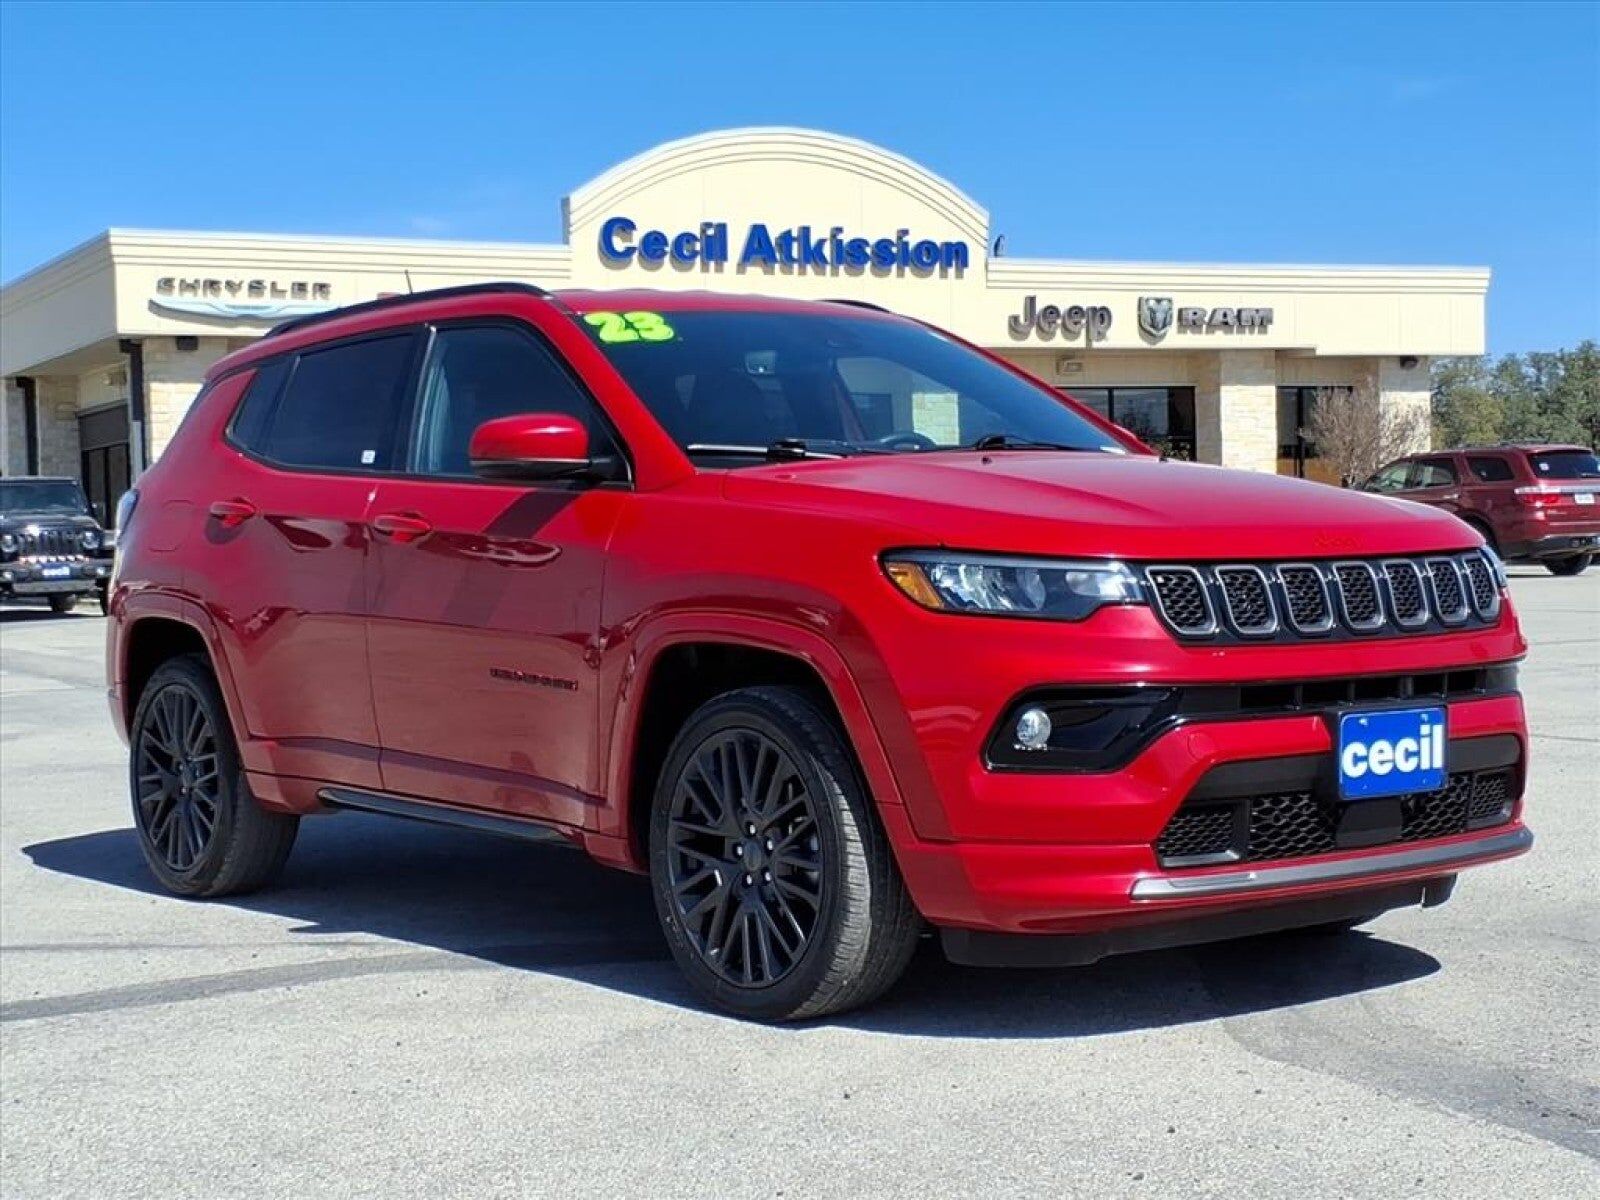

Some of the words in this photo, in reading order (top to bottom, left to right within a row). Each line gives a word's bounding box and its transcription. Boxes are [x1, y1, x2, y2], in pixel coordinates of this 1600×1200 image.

[599, 216, 728, 266] Cecil
[739, 223, 969, 272] Atkission
[157, 277, 331, 299] CHRYSLER
[583, 311, 674, 342] 23
[1008, 295, 1112, 345] Jeep
[1178, 307, 1273, 333] RAM
[1343, 724, 1443, 778] cecil
